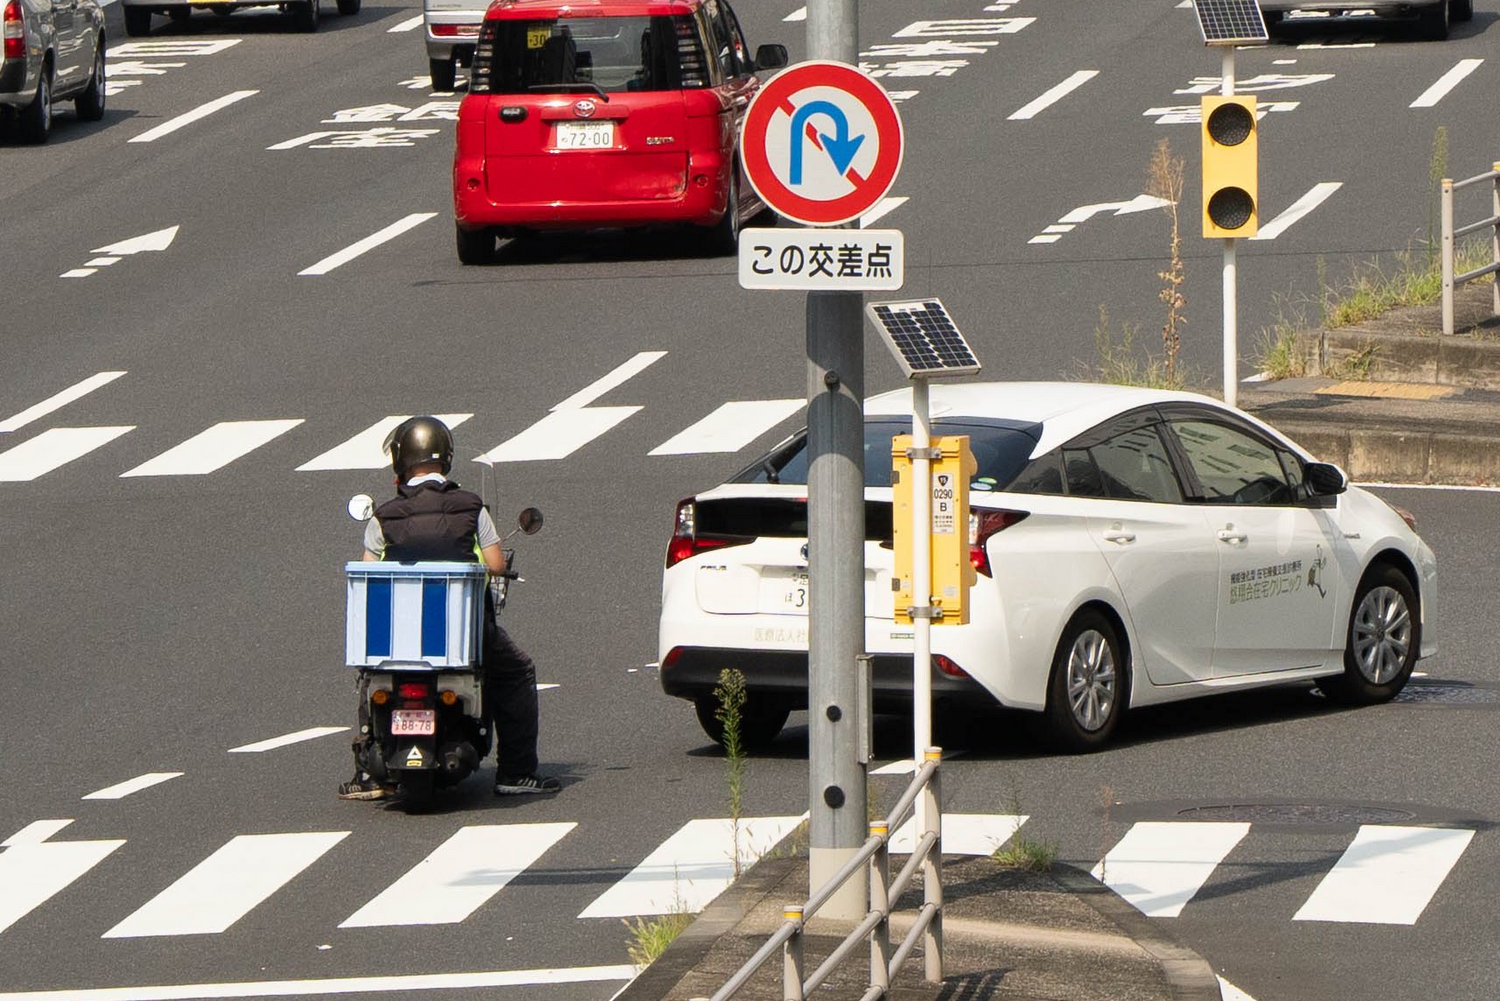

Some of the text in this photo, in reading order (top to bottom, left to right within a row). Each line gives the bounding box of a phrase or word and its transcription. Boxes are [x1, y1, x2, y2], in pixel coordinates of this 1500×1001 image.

[569, 132, 610, 146] 72-00
[751, 242, 893, 278] この交差点
[933, 488, 953, 500] 0290
[939, 502, 948, 512] B
[795, 588, 806, 608] 3
